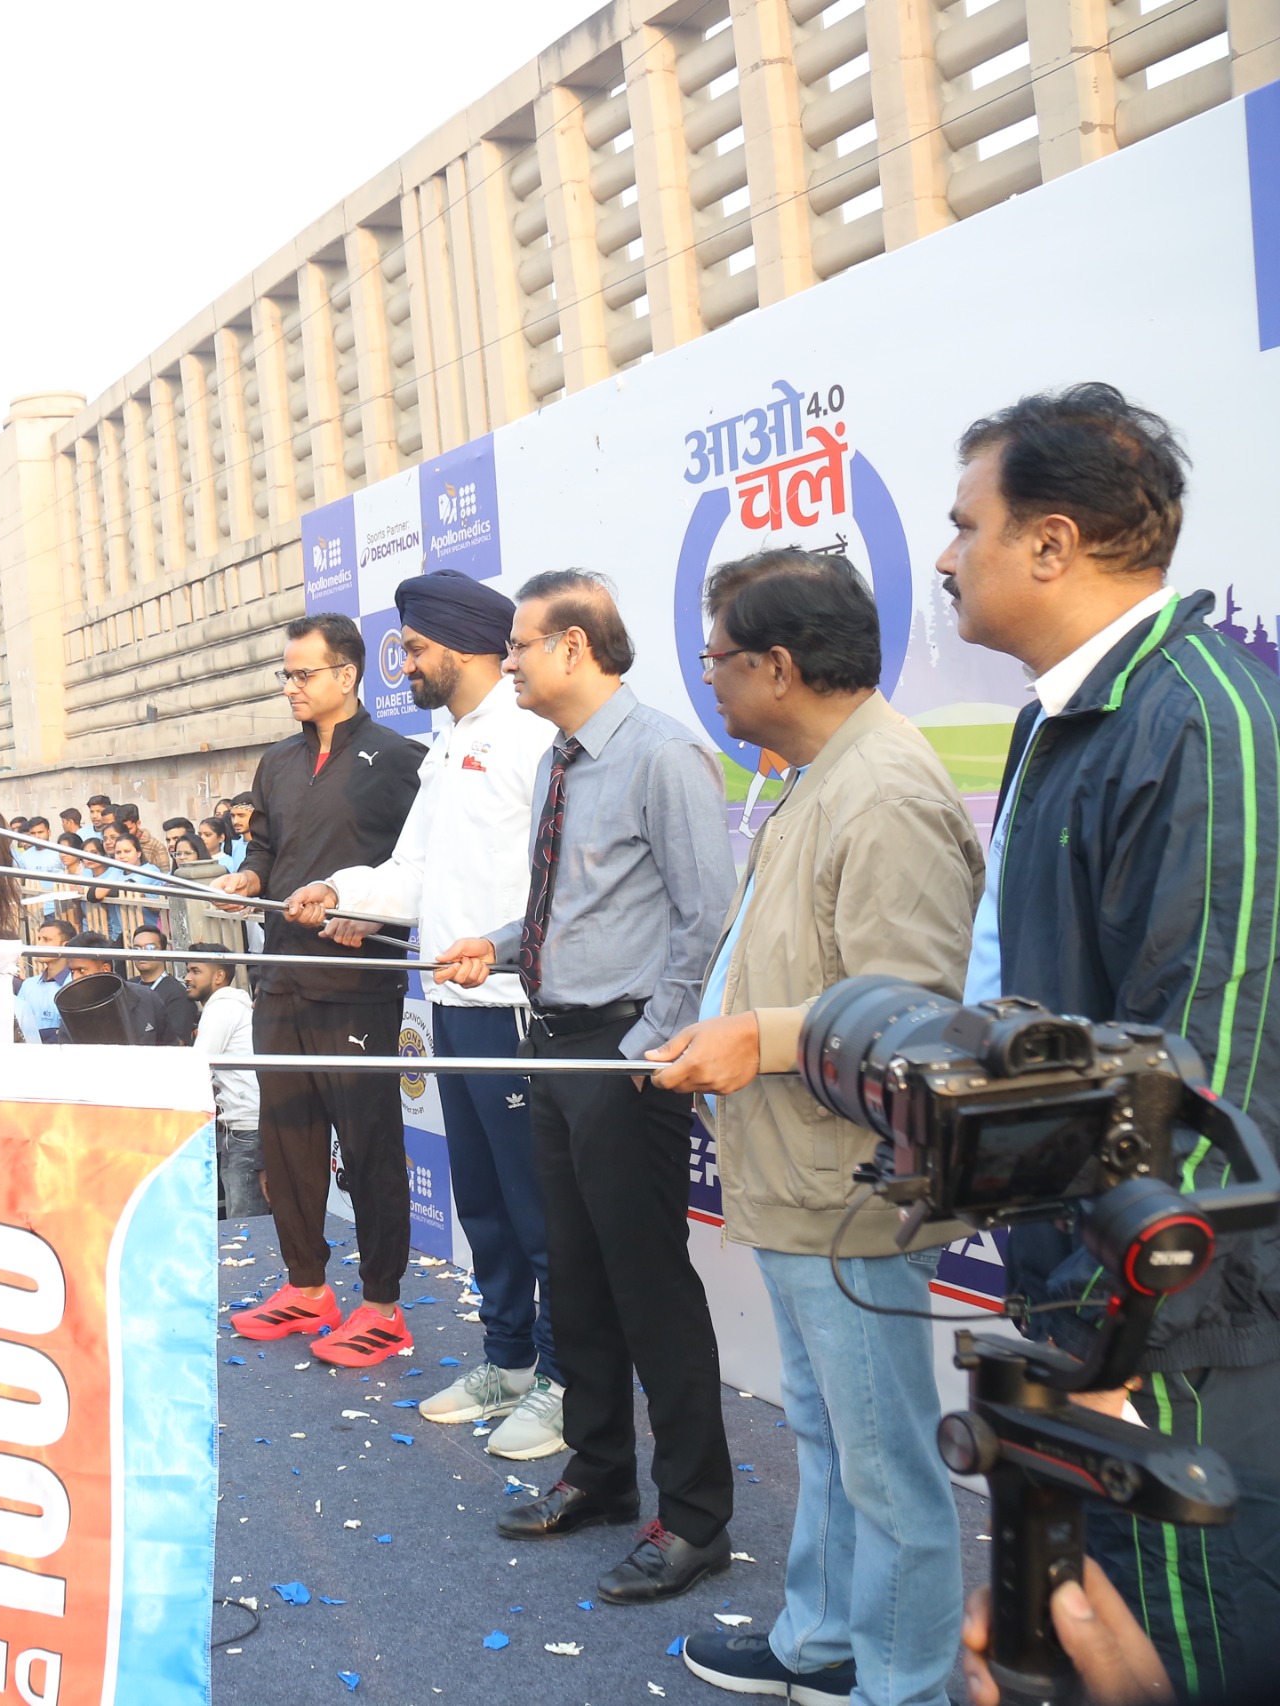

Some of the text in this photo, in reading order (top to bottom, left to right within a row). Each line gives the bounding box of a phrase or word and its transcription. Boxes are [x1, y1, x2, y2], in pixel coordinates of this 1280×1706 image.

[684, 380, 845, 484] आओ 4.0
[736, 421, 848, 531] चलें
[366, 528, 385, 545] Sports
[371, 531, 420, 562] DECATHLON
[430, 518, 491, 559] Apollomedics
[307, 569, 352, 600] Apollomedics
[375, 689, 414, 709] DIABETE
[376, 706, 400, 719] CONTROL
[400, 1031, 421, 1048] LIONS
